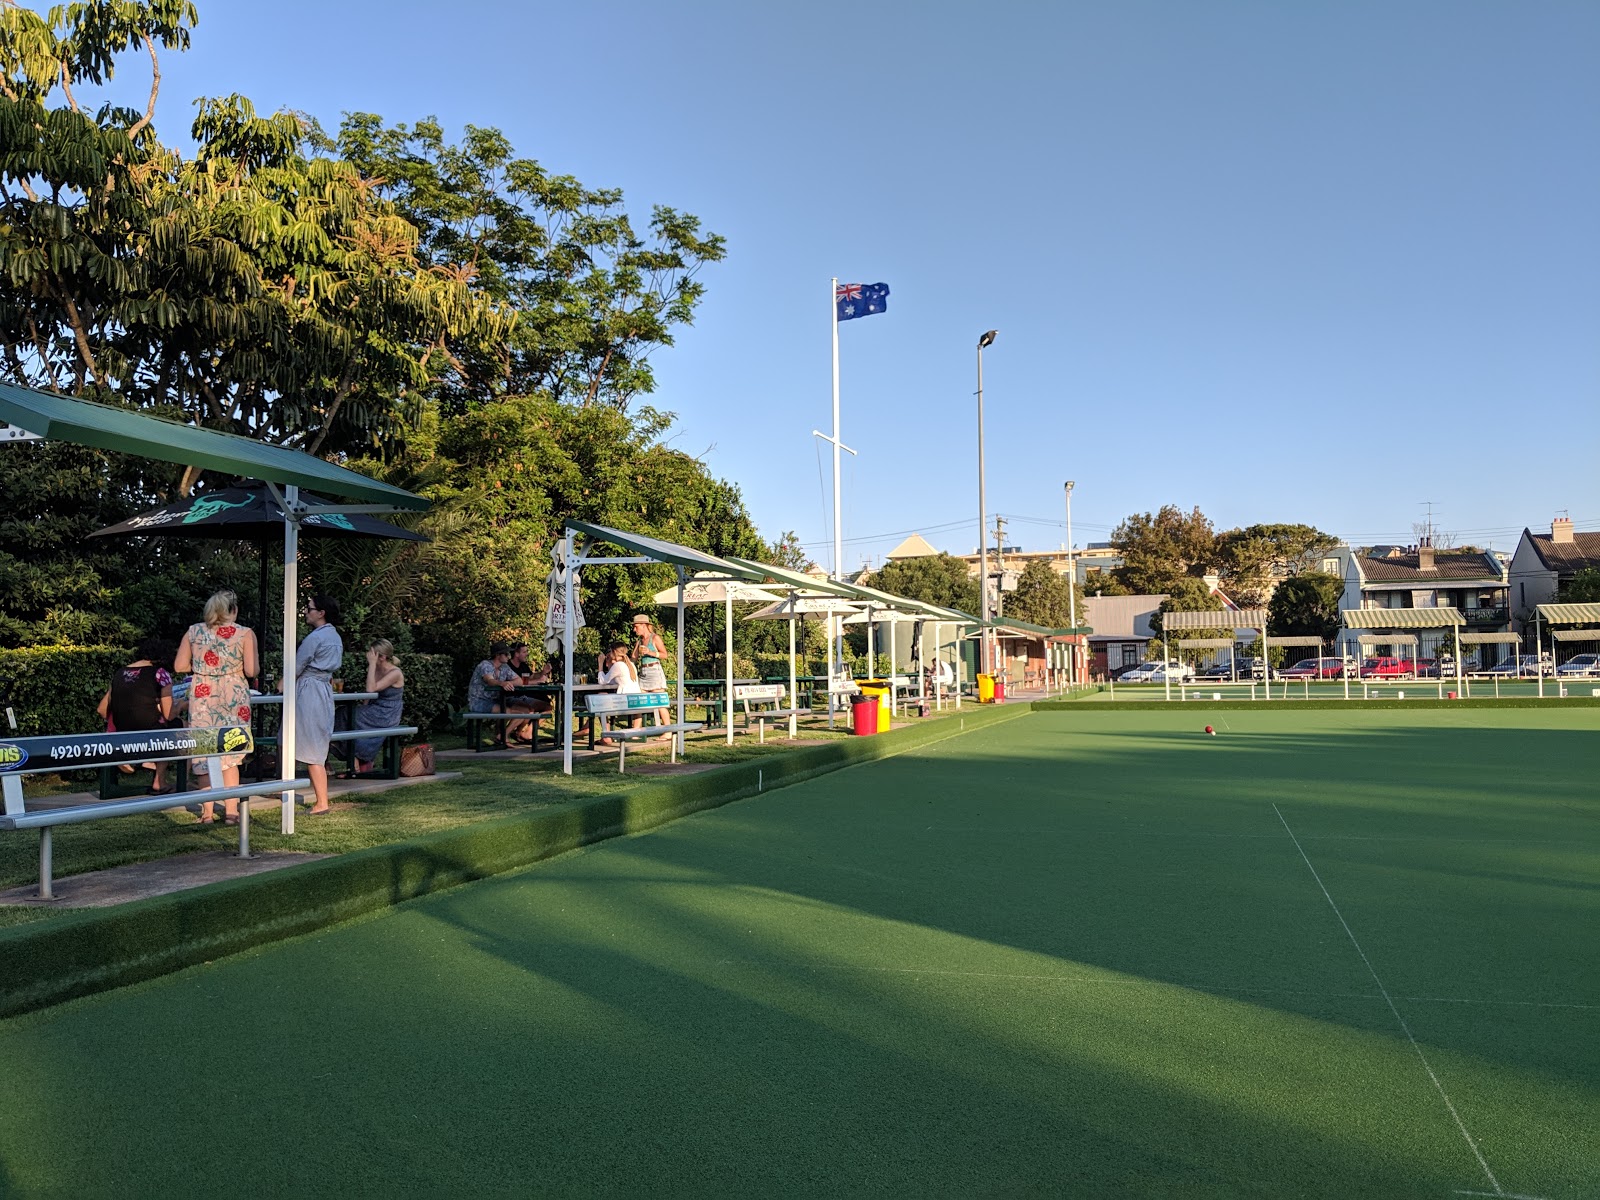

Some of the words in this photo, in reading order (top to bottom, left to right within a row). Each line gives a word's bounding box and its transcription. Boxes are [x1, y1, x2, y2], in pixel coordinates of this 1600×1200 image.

[50, 746, 81, 760] 4920
[83, 742, 113, 757] 2700
[121, 738, 197, 754] www.hivis.com
